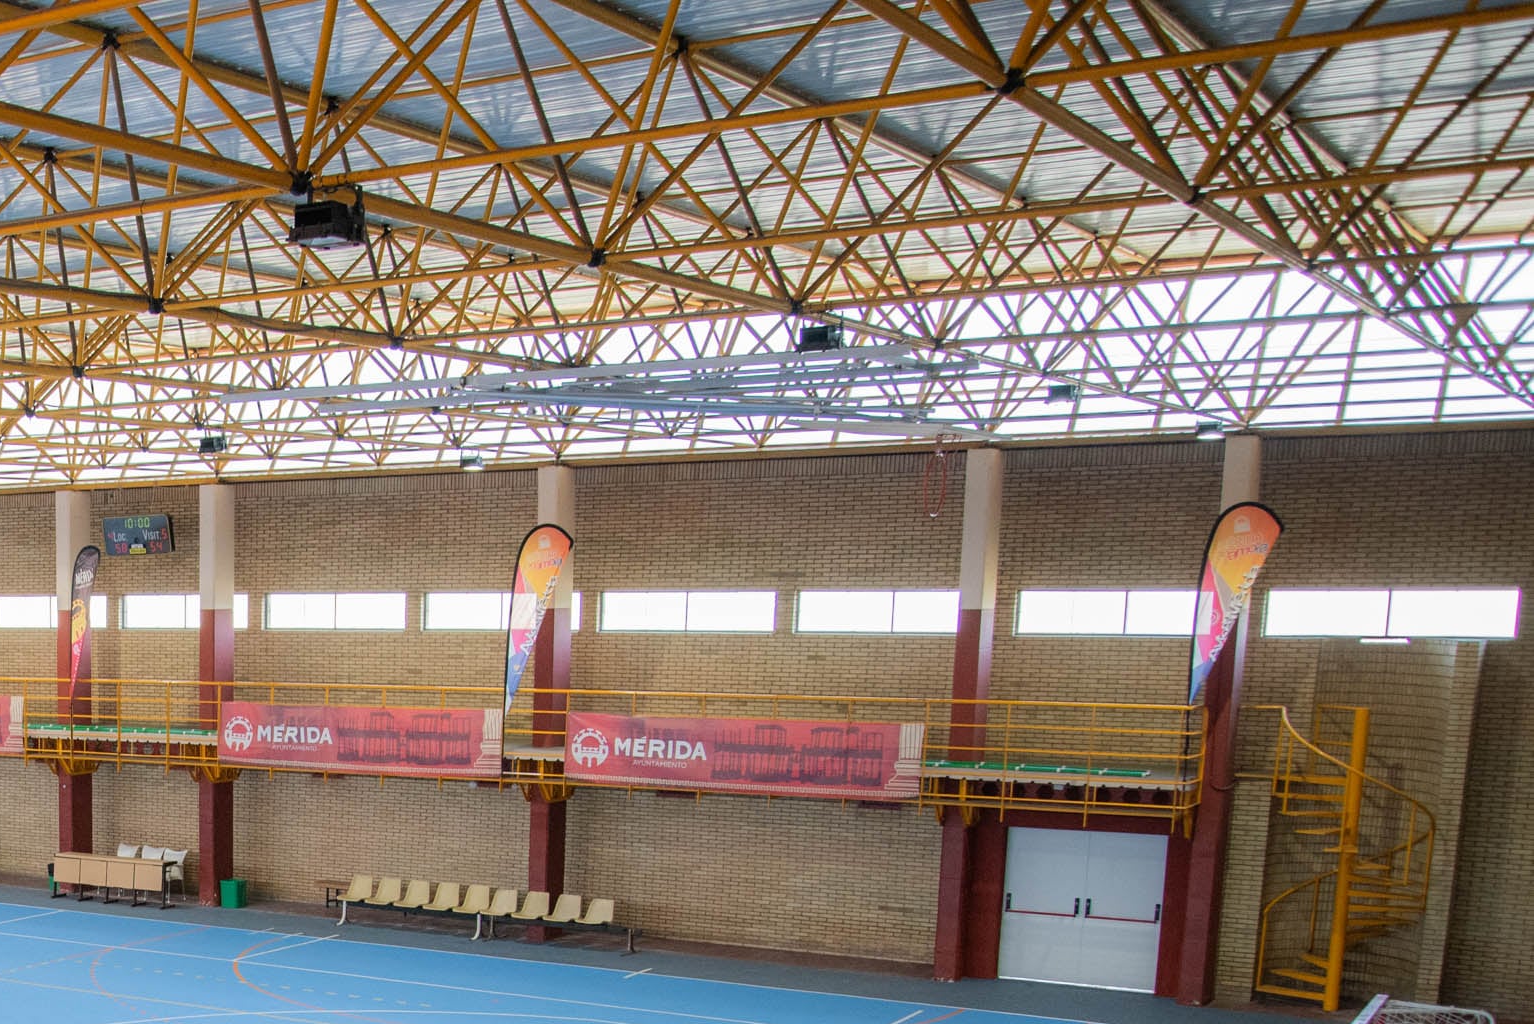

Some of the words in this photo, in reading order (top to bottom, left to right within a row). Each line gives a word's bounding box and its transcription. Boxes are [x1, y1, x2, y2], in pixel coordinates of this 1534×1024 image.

[257, 723, 333, 745] MÉRIDA
[614, 736, 707, 761] MÉRIDA
[633, 759, 688, 769] AYUNTAMIENTO
